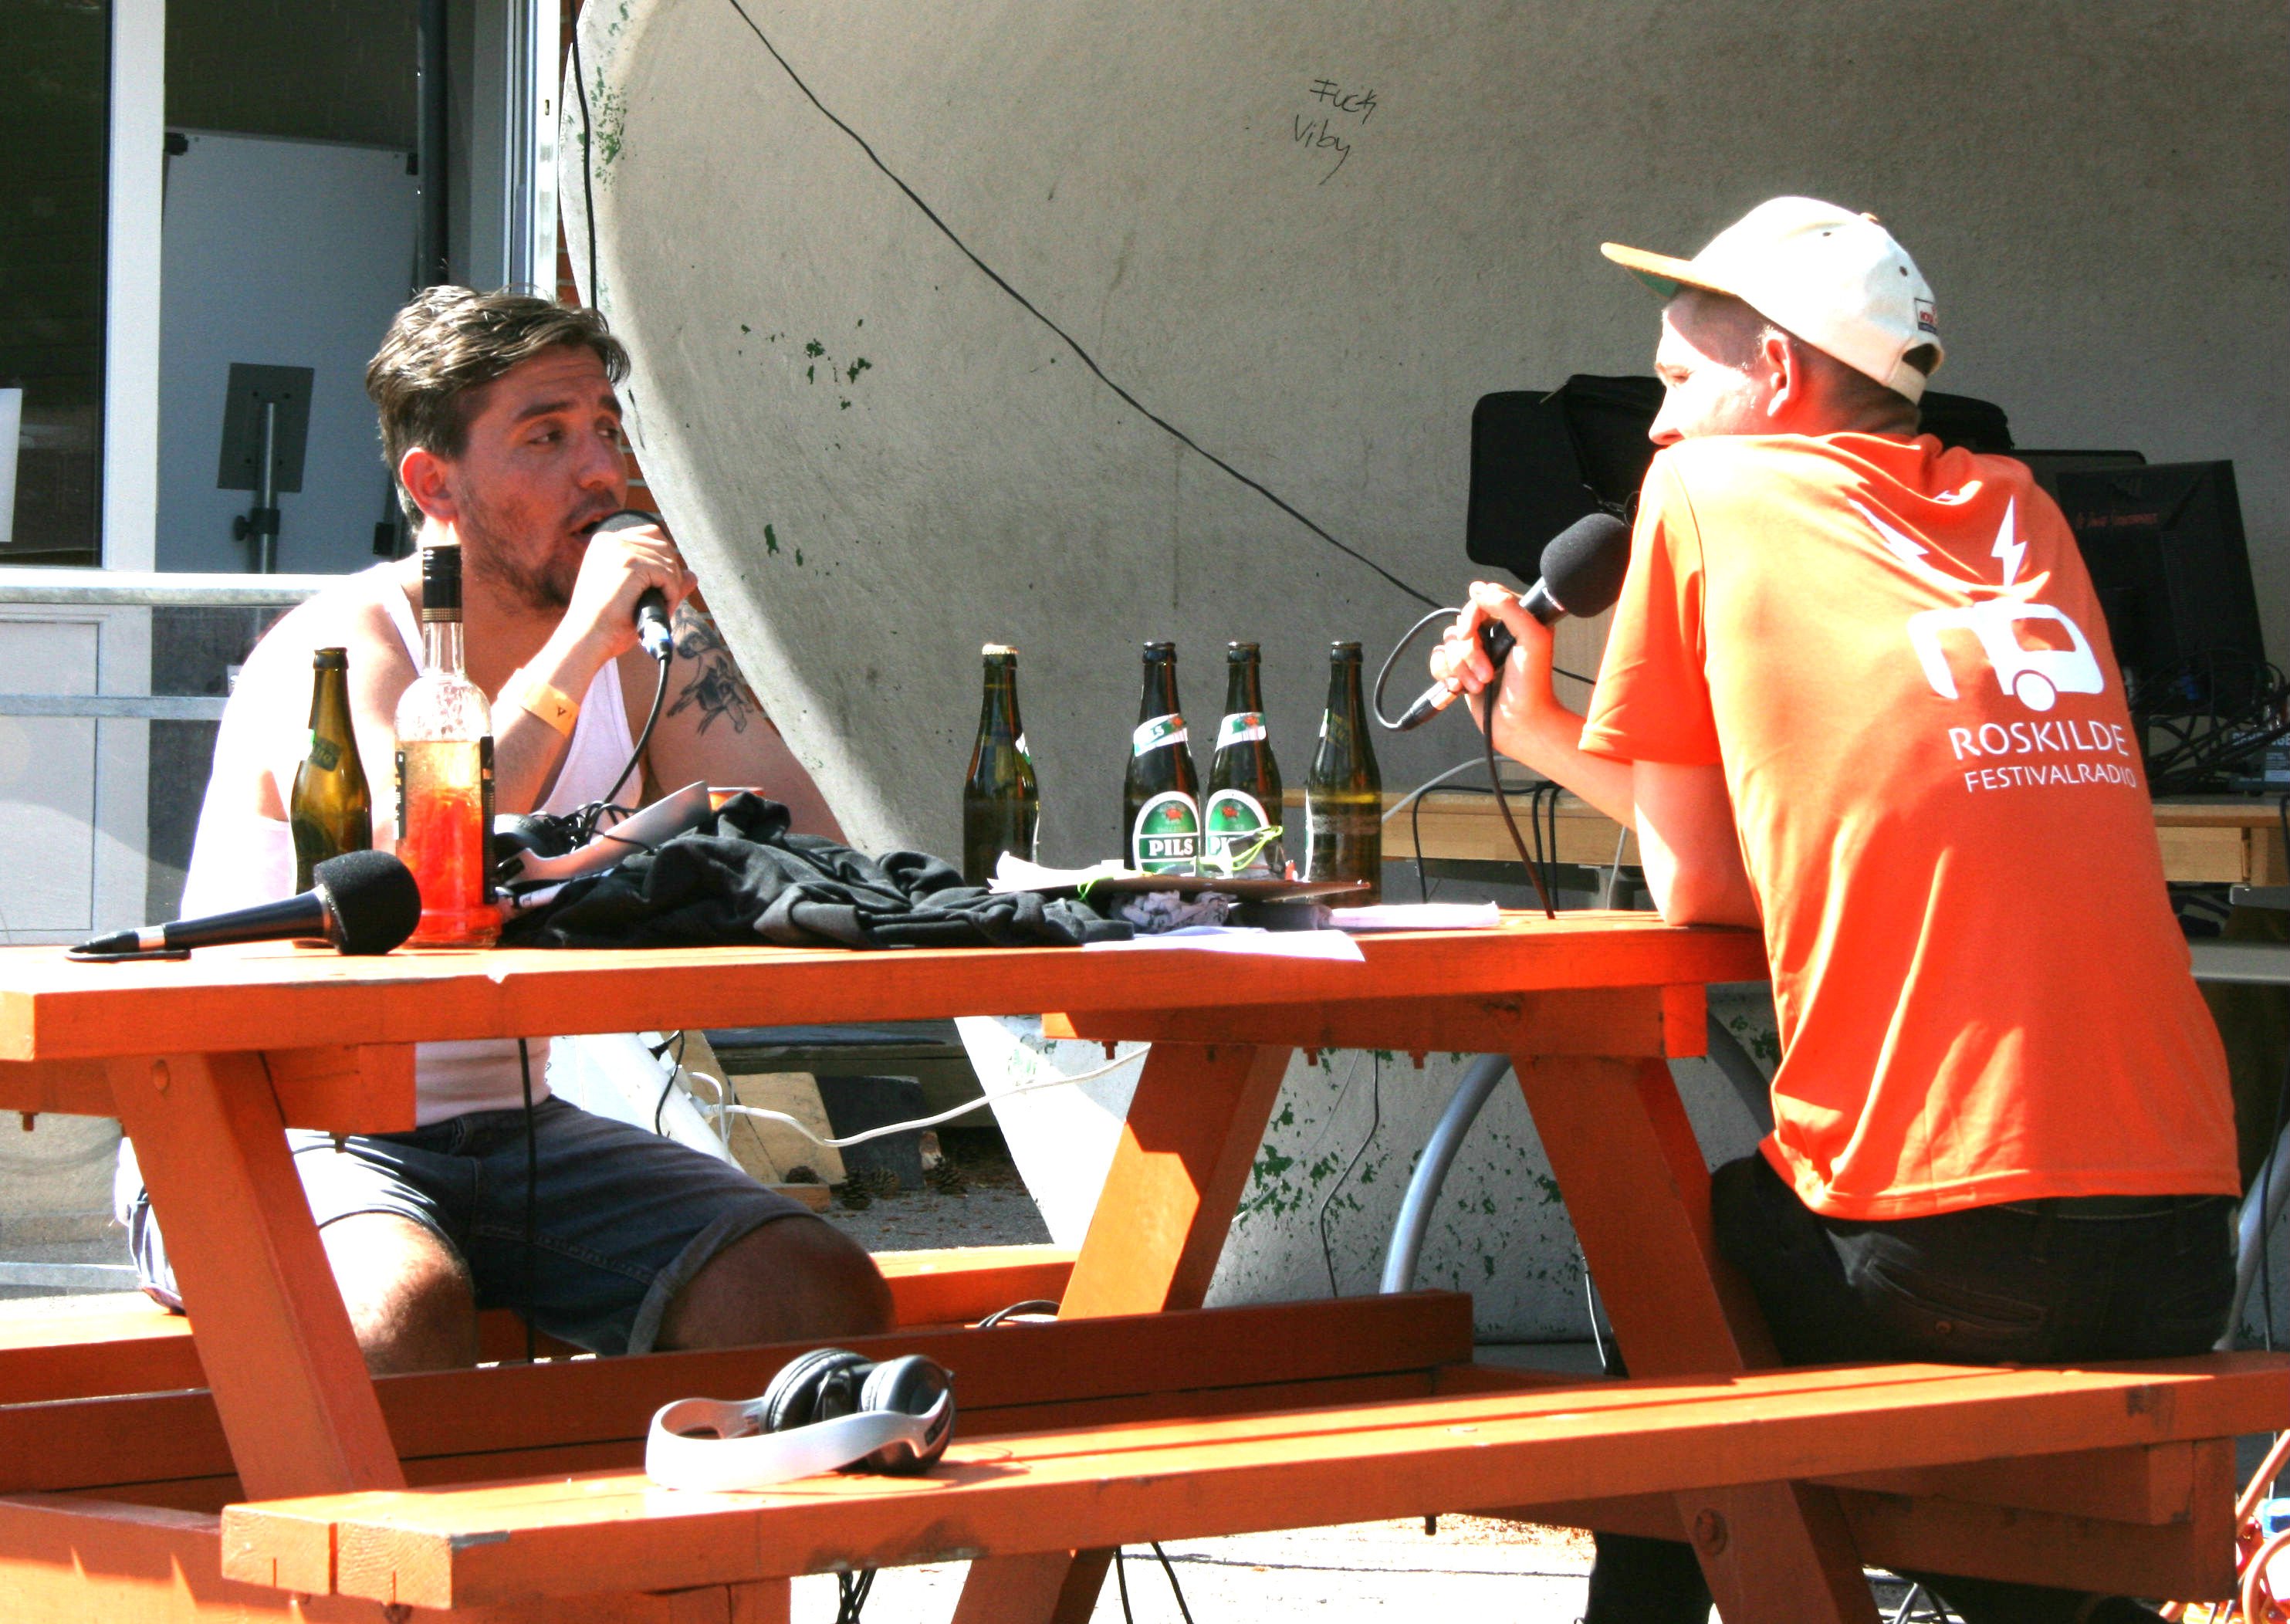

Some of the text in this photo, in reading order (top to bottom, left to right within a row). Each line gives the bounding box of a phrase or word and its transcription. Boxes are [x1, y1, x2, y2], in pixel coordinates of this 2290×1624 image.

[1309, 79, 1377, 125] Fuck
[1294, 114, 1350, 185] Viby
[1949, 720, 2129, 760] ROSKILDE
[1964, 763, 2136, 793] FESTIVALRADIO
[1148, 838, 1193, 856] PILS
